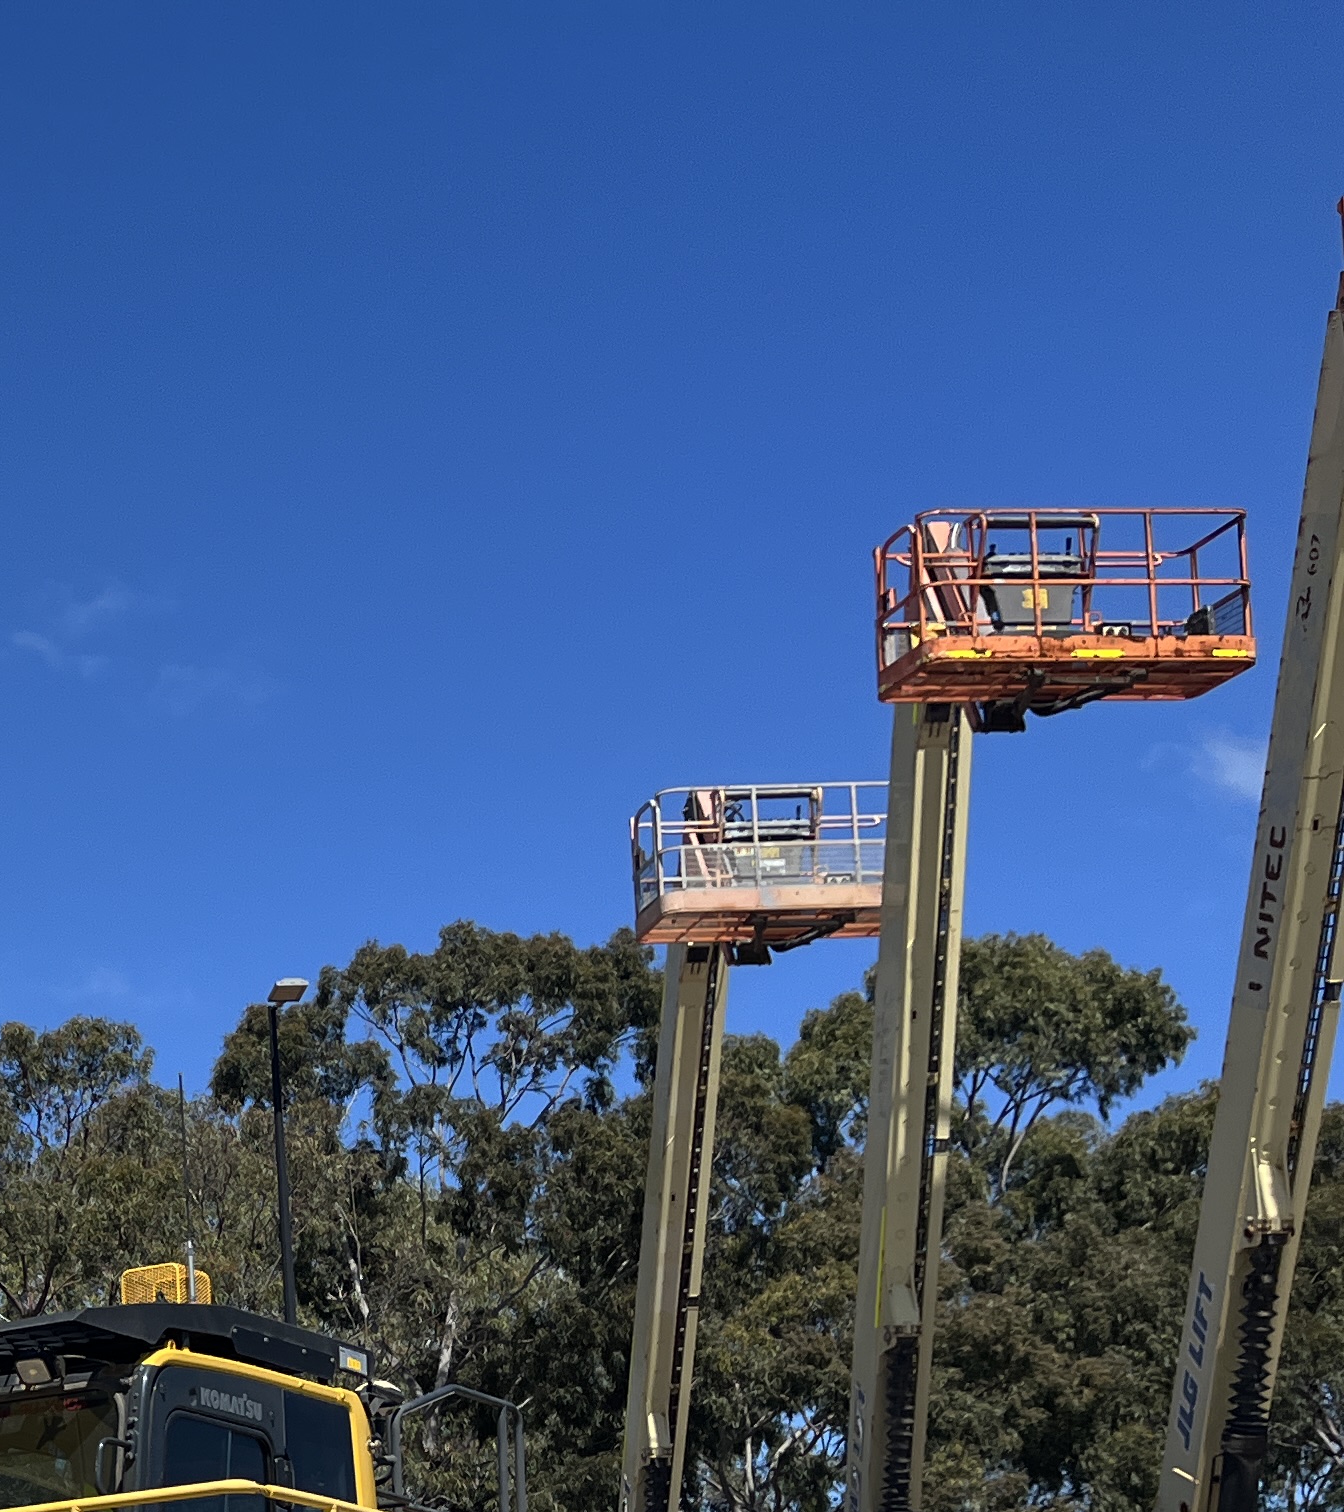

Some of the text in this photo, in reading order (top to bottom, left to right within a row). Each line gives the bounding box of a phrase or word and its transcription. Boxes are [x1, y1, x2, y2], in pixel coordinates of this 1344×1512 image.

[199, 1386, 263, 1421] KOMATSU
[1177, 1271, 1213, 1451] JLG LIFT
